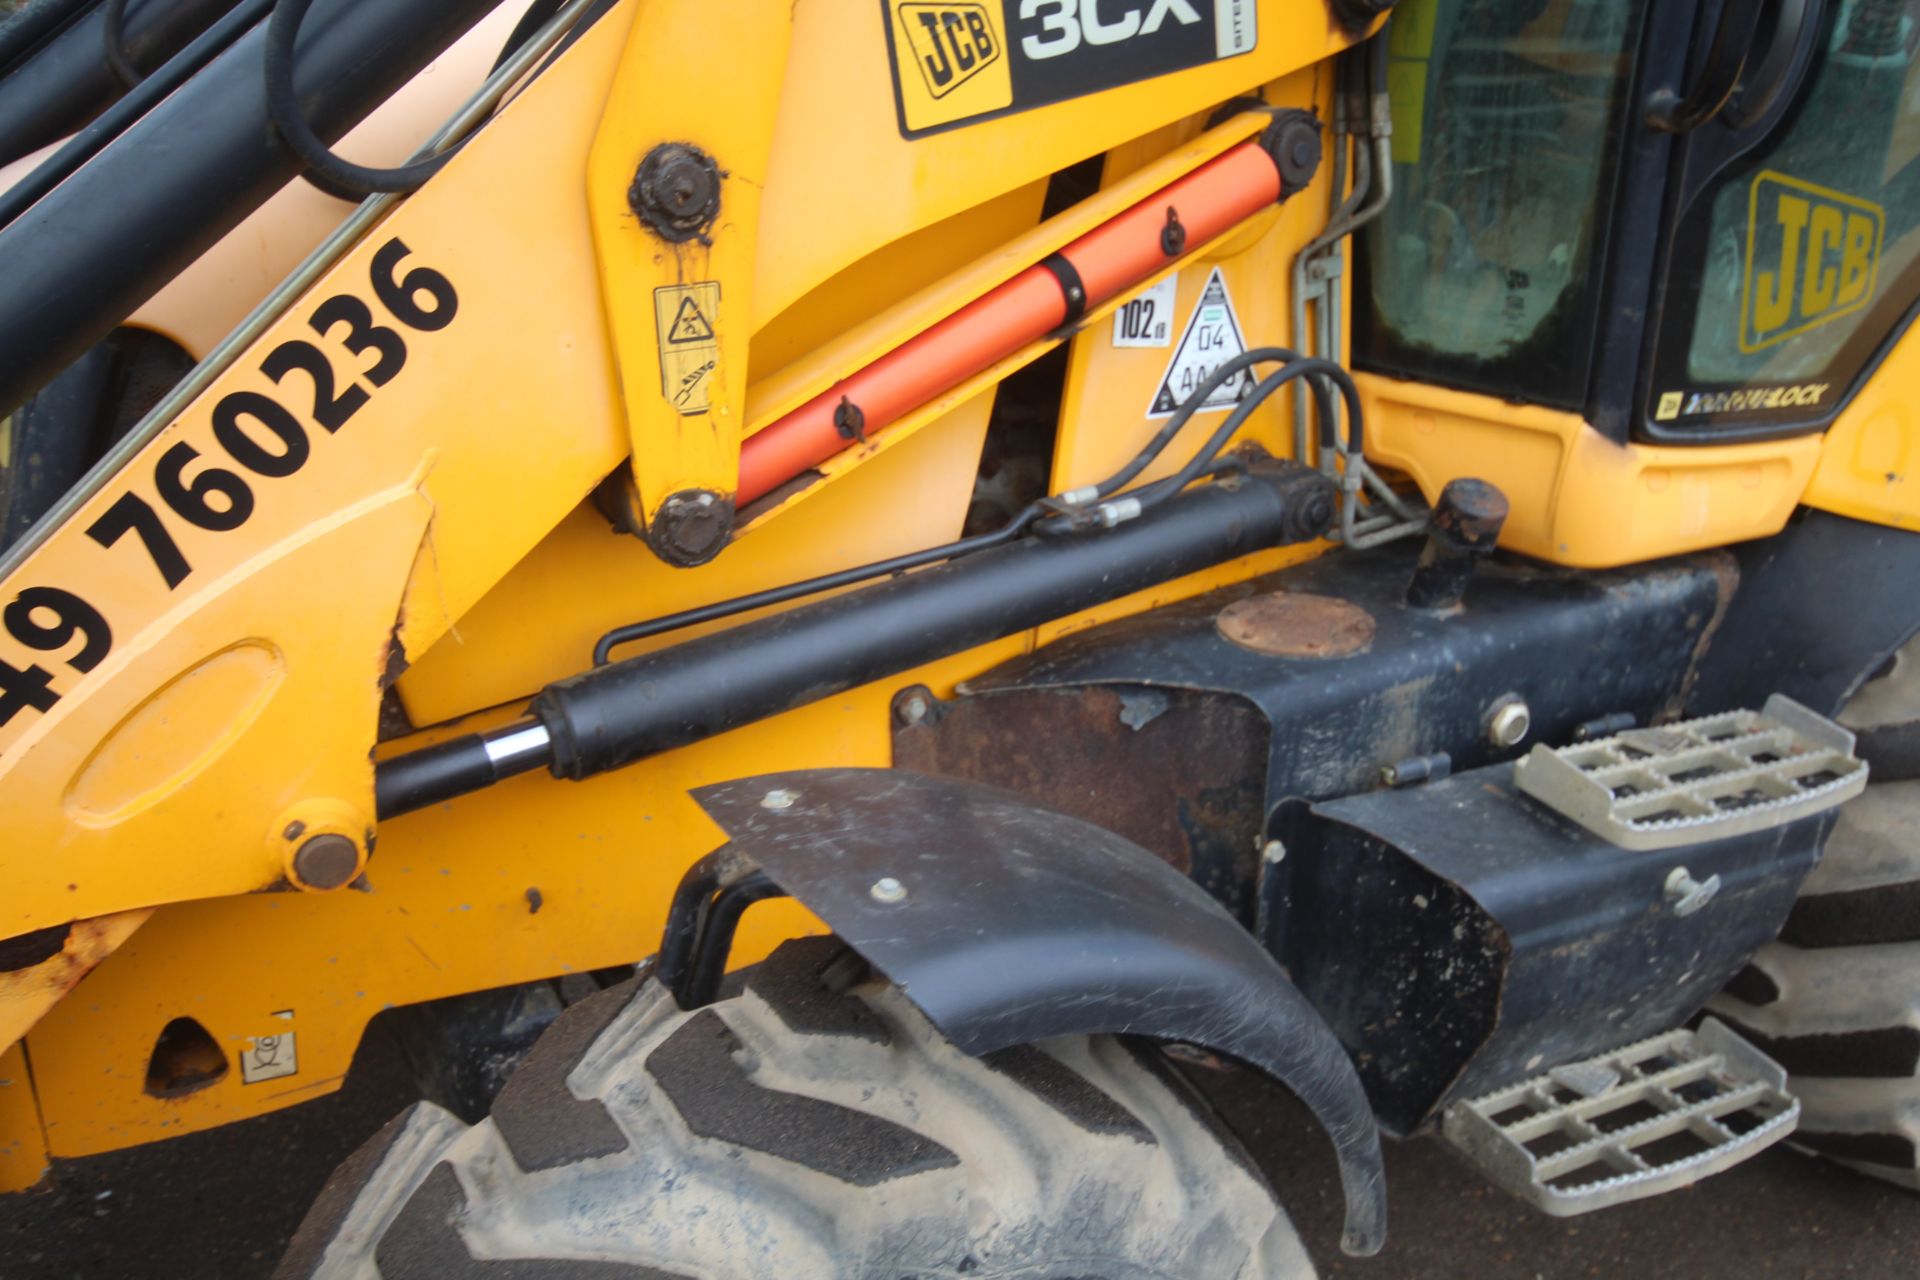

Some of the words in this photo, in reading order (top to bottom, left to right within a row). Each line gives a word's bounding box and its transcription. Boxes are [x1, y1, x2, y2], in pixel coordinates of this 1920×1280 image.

[917, 11, 991, 87] JCB
[1232, 0, 1243, 49] SITE
[1753, 193, 1874, 334] JCB
[1121, 299, 1155, 339] 102
[85, 236, 459, 591] 760236
